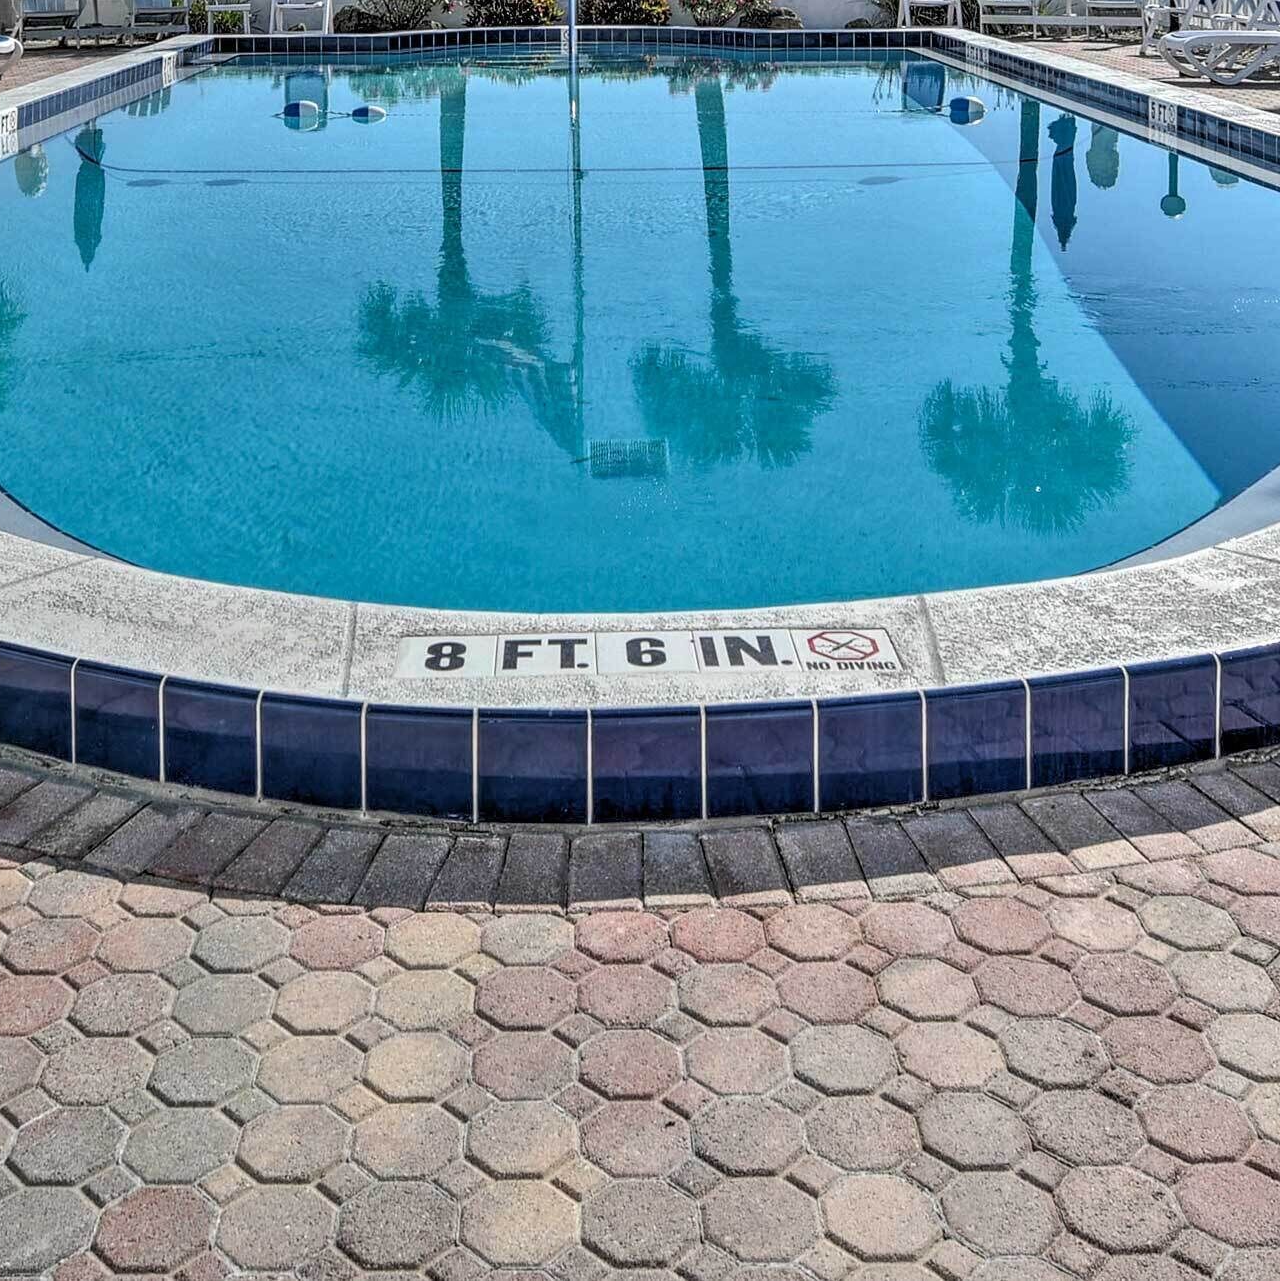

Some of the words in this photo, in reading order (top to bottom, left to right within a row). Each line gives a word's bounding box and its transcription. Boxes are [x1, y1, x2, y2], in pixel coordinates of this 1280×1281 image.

[424, 641, 467, 671] 8
[502, 638, 590, 670] FT.
[625, 637, 667, 667] 6
[699, 635, 794, 667] IN.
[805, 661, 831, 670] NO
[836, 661, 897, 671] DIVING
